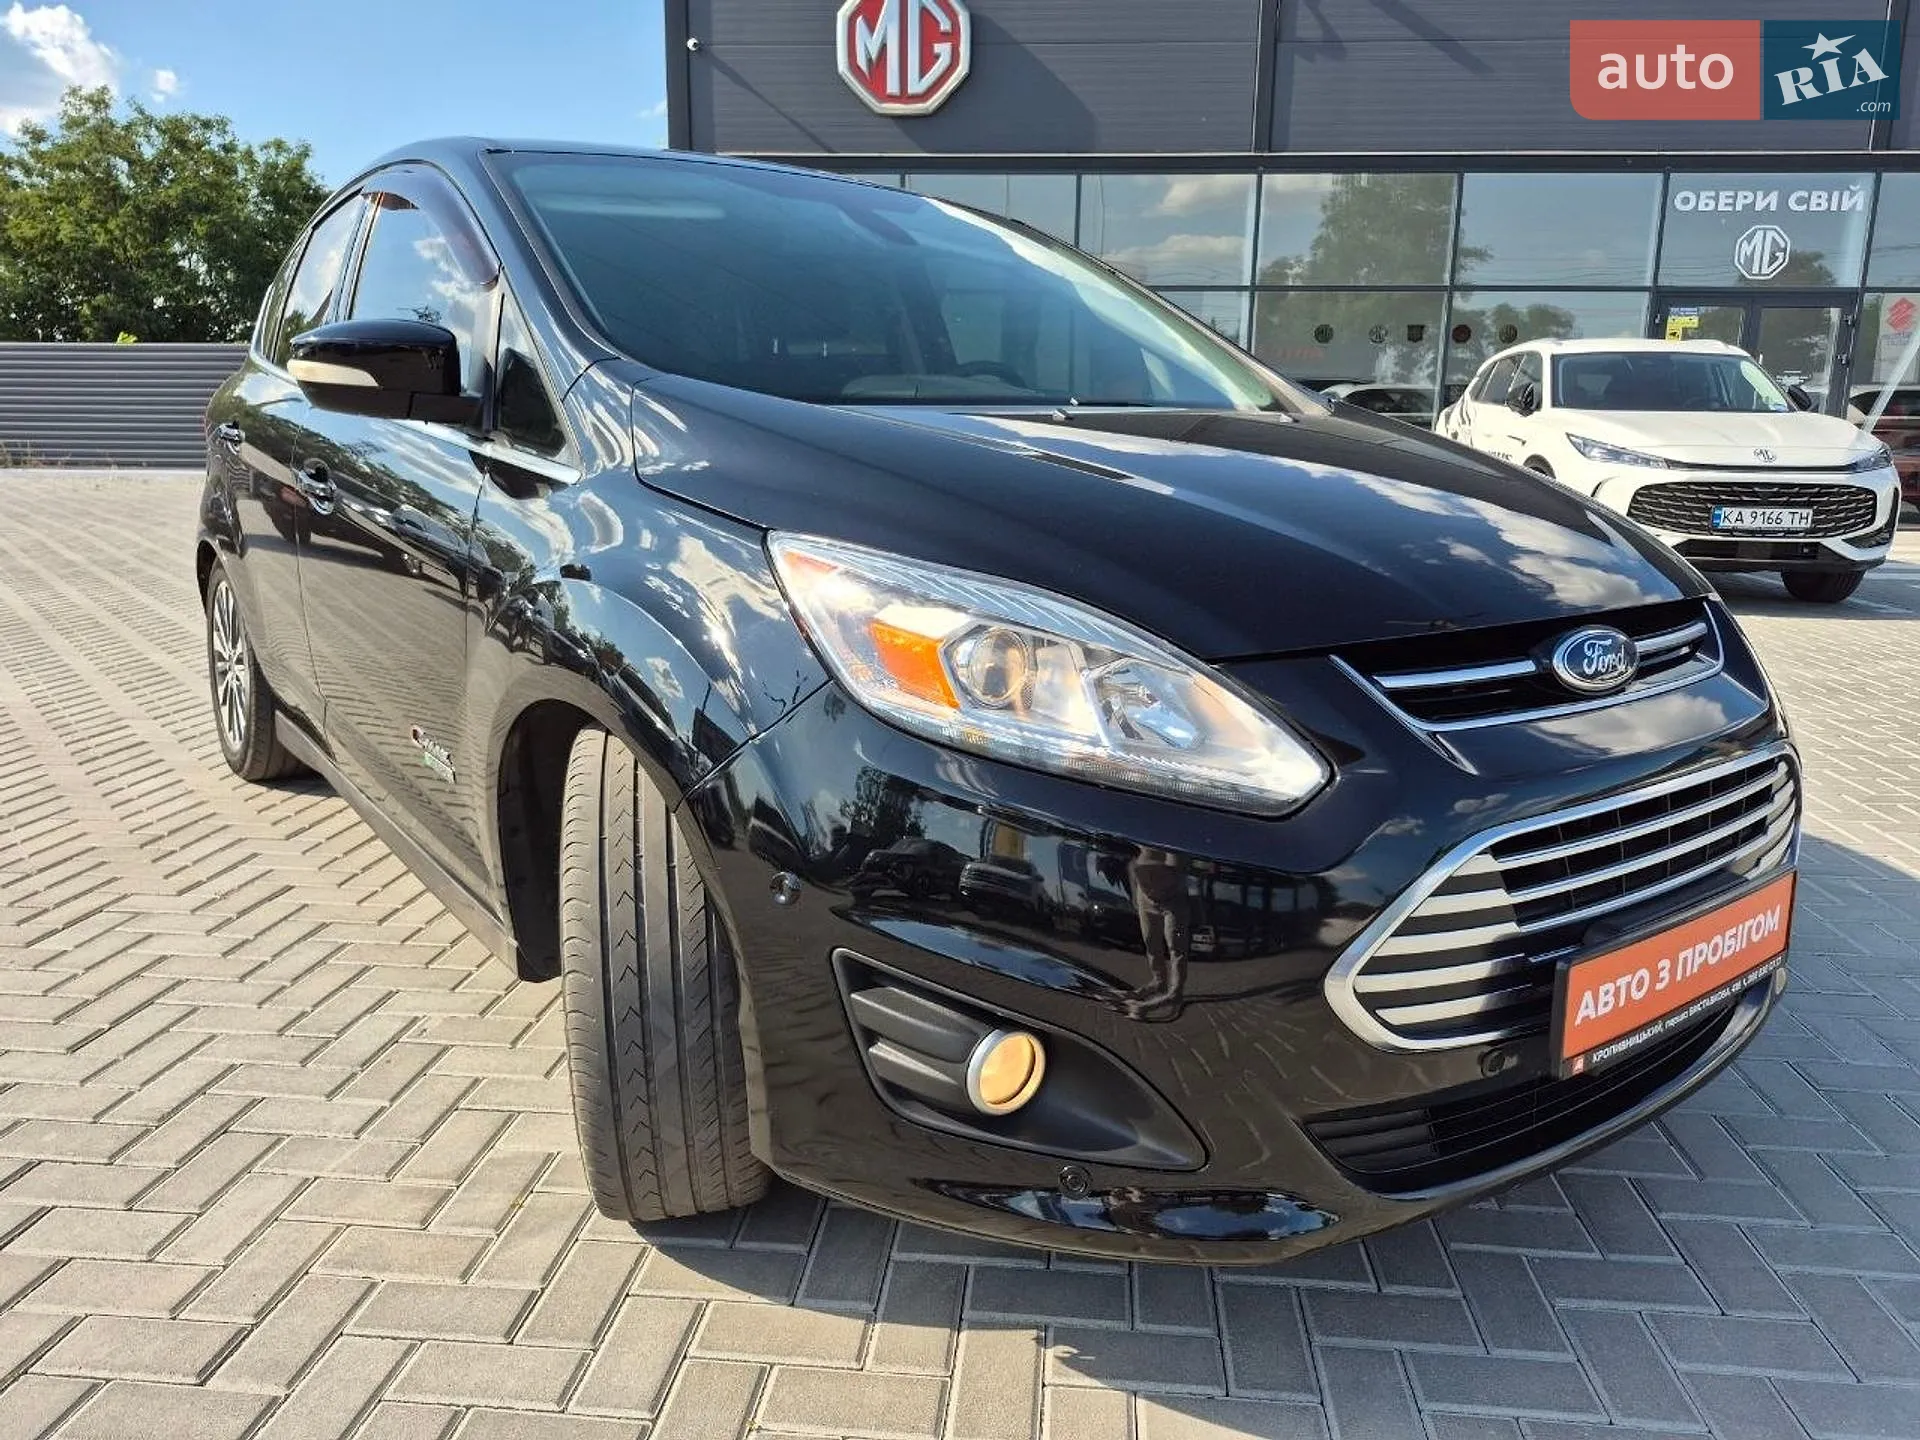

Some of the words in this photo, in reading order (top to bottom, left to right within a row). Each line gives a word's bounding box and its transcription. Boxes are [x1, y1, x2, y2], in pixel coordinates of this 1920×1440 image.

[856, 0, 952, 95] MG
[1674, 190, 1779, 212] ОБЕРИ
[1788, 185, 1866, 212] СВІЙ
[1739, 229, 1786, 275] MG
[1721, 511, 1745, 525] KA
[1750, 511, 1783, 525] 9166
[1787, 511, 1810, 526] TH
[1582, 638, 1627, 675] Ford
[1574, 967, 1650, 1027] АВТО
[1675, 904, 1782, 982] ПРОБІГОМ
